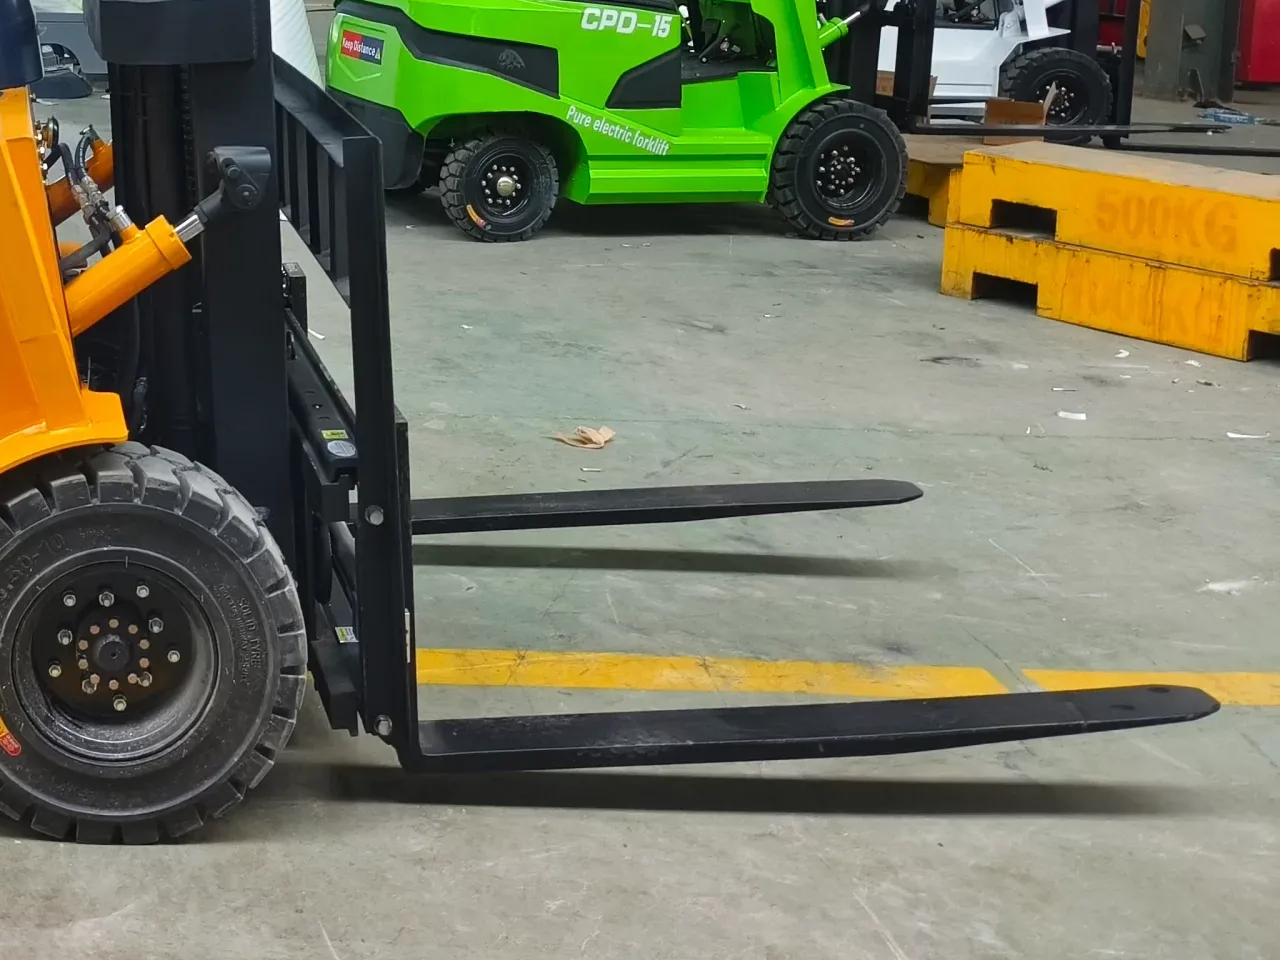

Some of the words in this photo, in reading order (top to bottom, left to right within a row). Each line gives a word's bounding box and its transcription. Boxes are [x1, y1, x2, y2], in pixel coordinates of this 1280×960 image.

[581, 7, 672, 38] CPD-15
[342, 37, 354, 52] Keep
[353, 40, 376, 56] Distance
[566, 105, 592, 127] Pure
[593, 117, 632, 143] electric
[632, 130, 670, 156] forklift
[1094, 188, 1238, 254] 500KG
